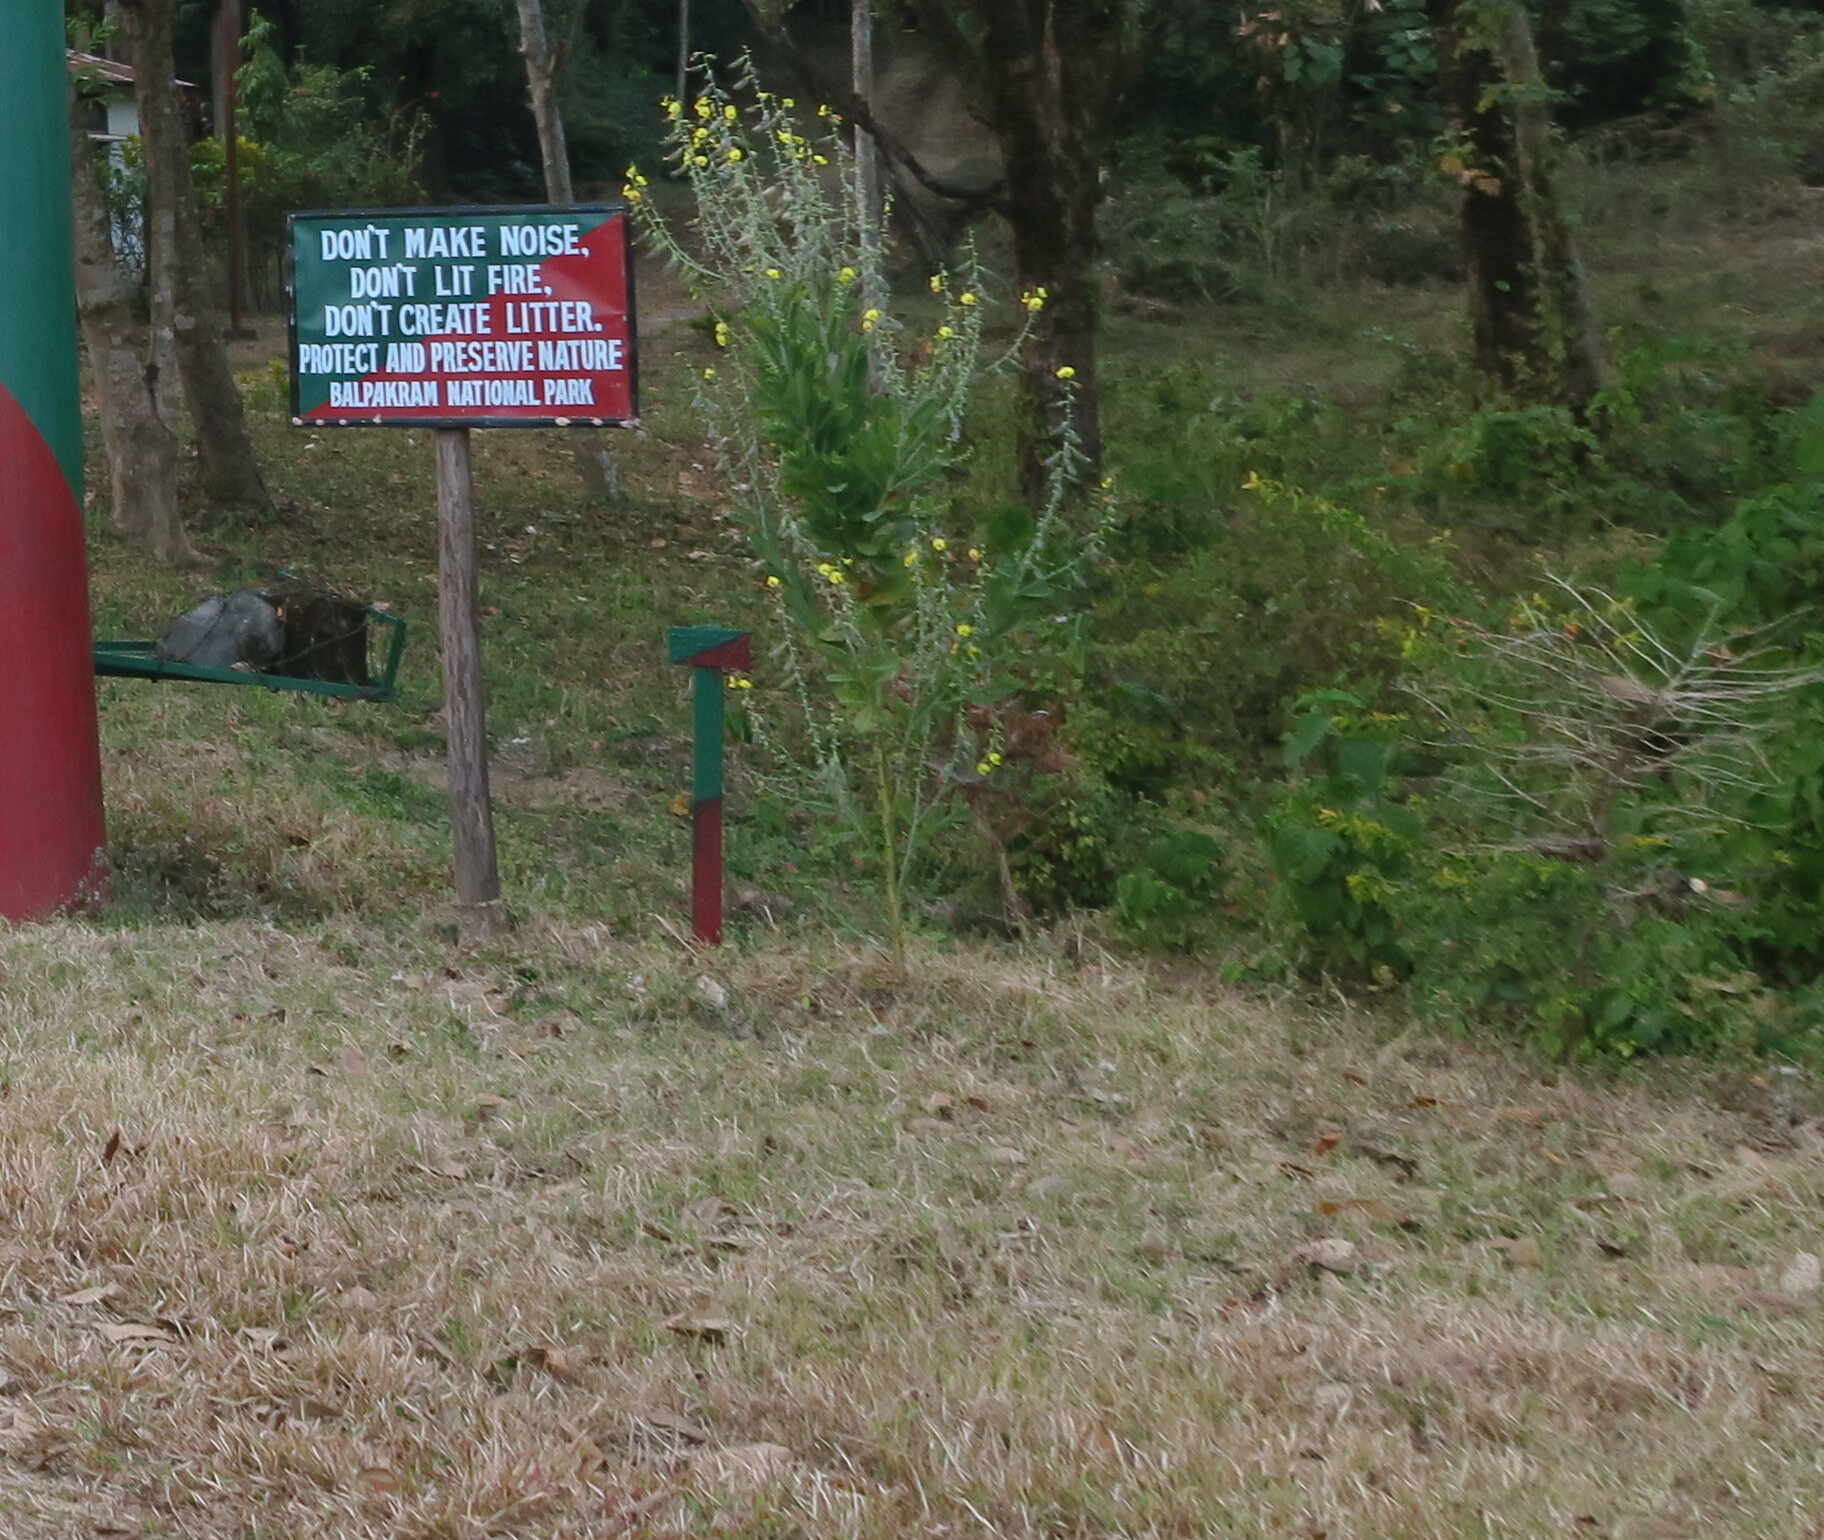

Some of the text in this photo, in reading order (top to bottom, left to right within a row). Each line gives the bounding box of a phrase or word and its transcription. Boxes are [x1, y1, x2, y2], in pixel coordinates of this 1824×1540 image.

[321, 224, 590, 260] DON'T MAKE NOISE,
[350, 262, 552, 298] DON'T LIT FIRE,
[324, 300, 602, 336] DON'T CREATE LITTER.
[299, 339, 623, 374] PROTECT AND PRESERVE NATURE
[330, 379, 594, 408] BALPAKRAM NATIONAL PARK
